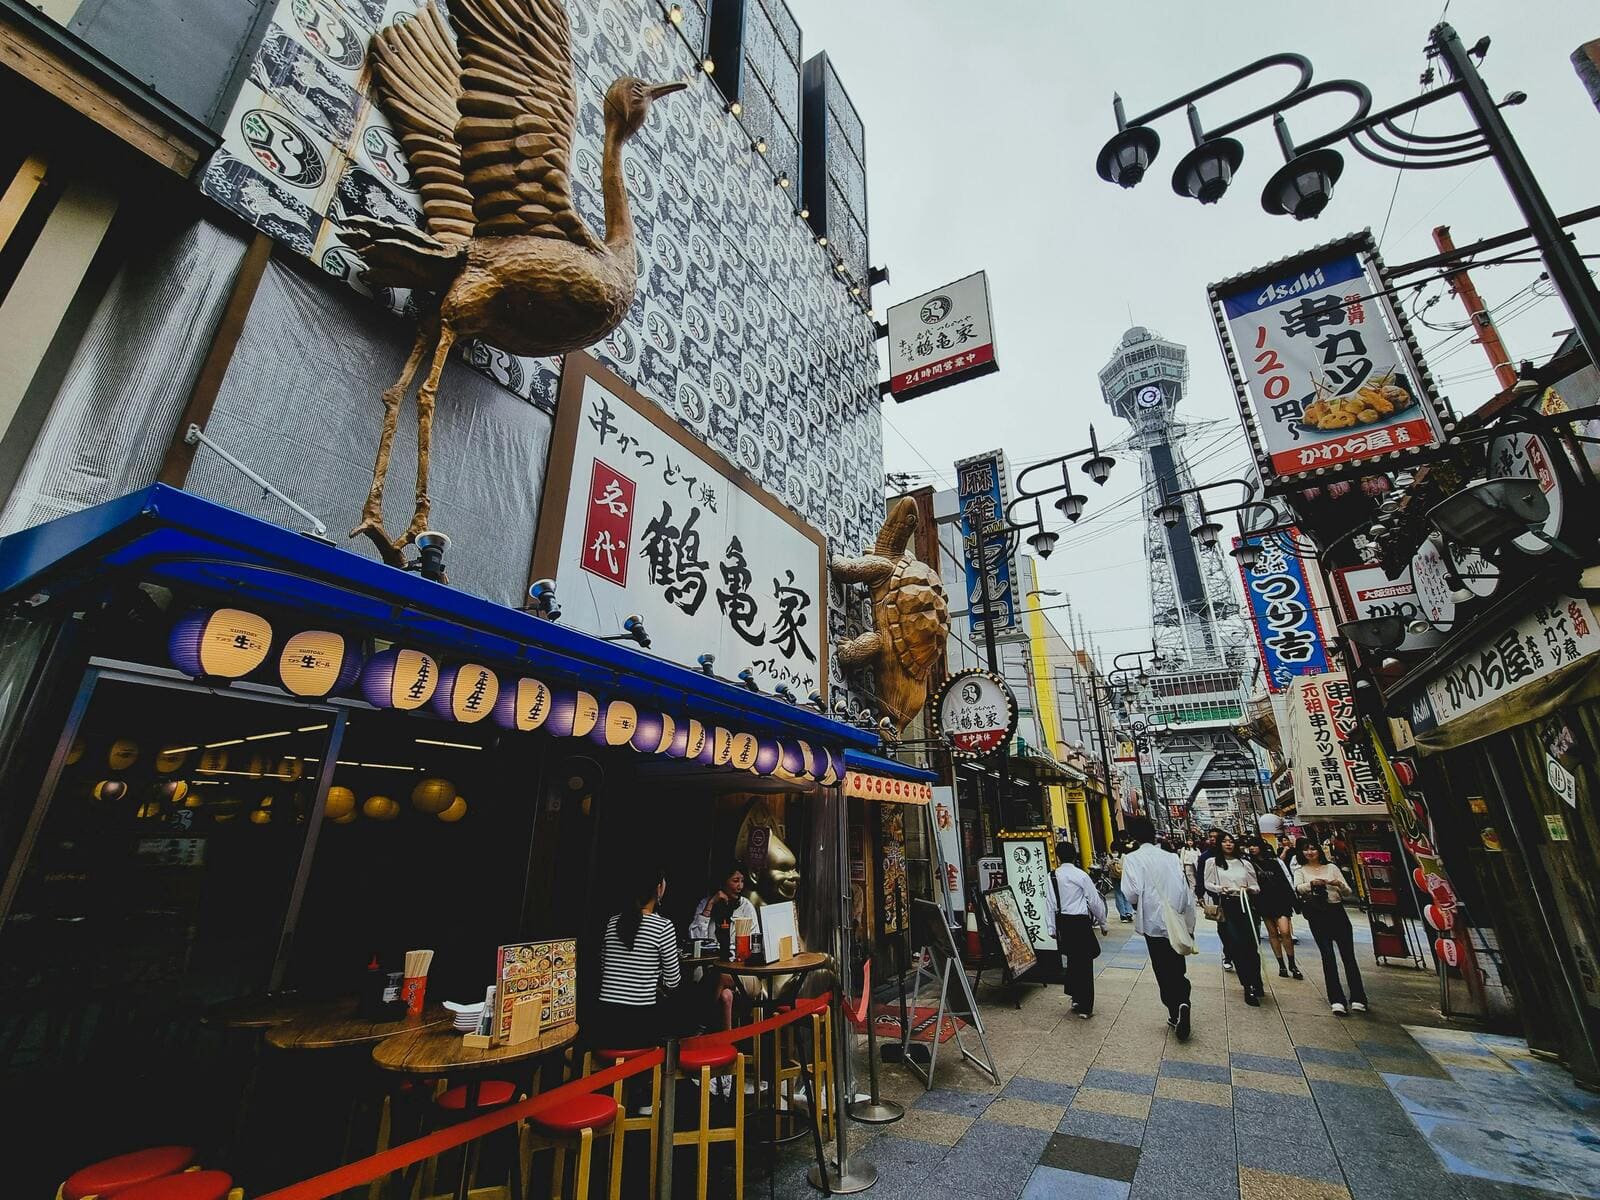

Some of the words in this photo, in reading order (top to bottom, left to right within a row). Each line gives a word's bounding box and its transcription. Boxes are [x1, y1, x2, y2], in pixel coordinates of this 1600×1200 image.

[1257, 267, 1326, 306] Asahi
[905, 353, 976, 385] 24時間営業中
[916, 324, 978, 356] 鶴亀家
[1279, 294, 1373, 396] 串カツ
[588, 396, 654, 466] 串かつ
[663, 455, 717, 513] どて焼
[1299, 431, 1393, 465] かわら屋
[590, 479, 629, 575] 名代
[959, 463, 998, 528] 麻雀
[639, 500, 817, 665] 鶴亀家
[1253, 574, 1314, 662] つり吉
[752, 658, 815, 691] つるかめや
[1445, 628, 1535, 711] かわら屋
[1526, 635, 1544, 670] 本店
[1300, 683, 1349, 806] 元祖串カツ専門店
[1018, 874, 1045, 943] 鶴亀家
